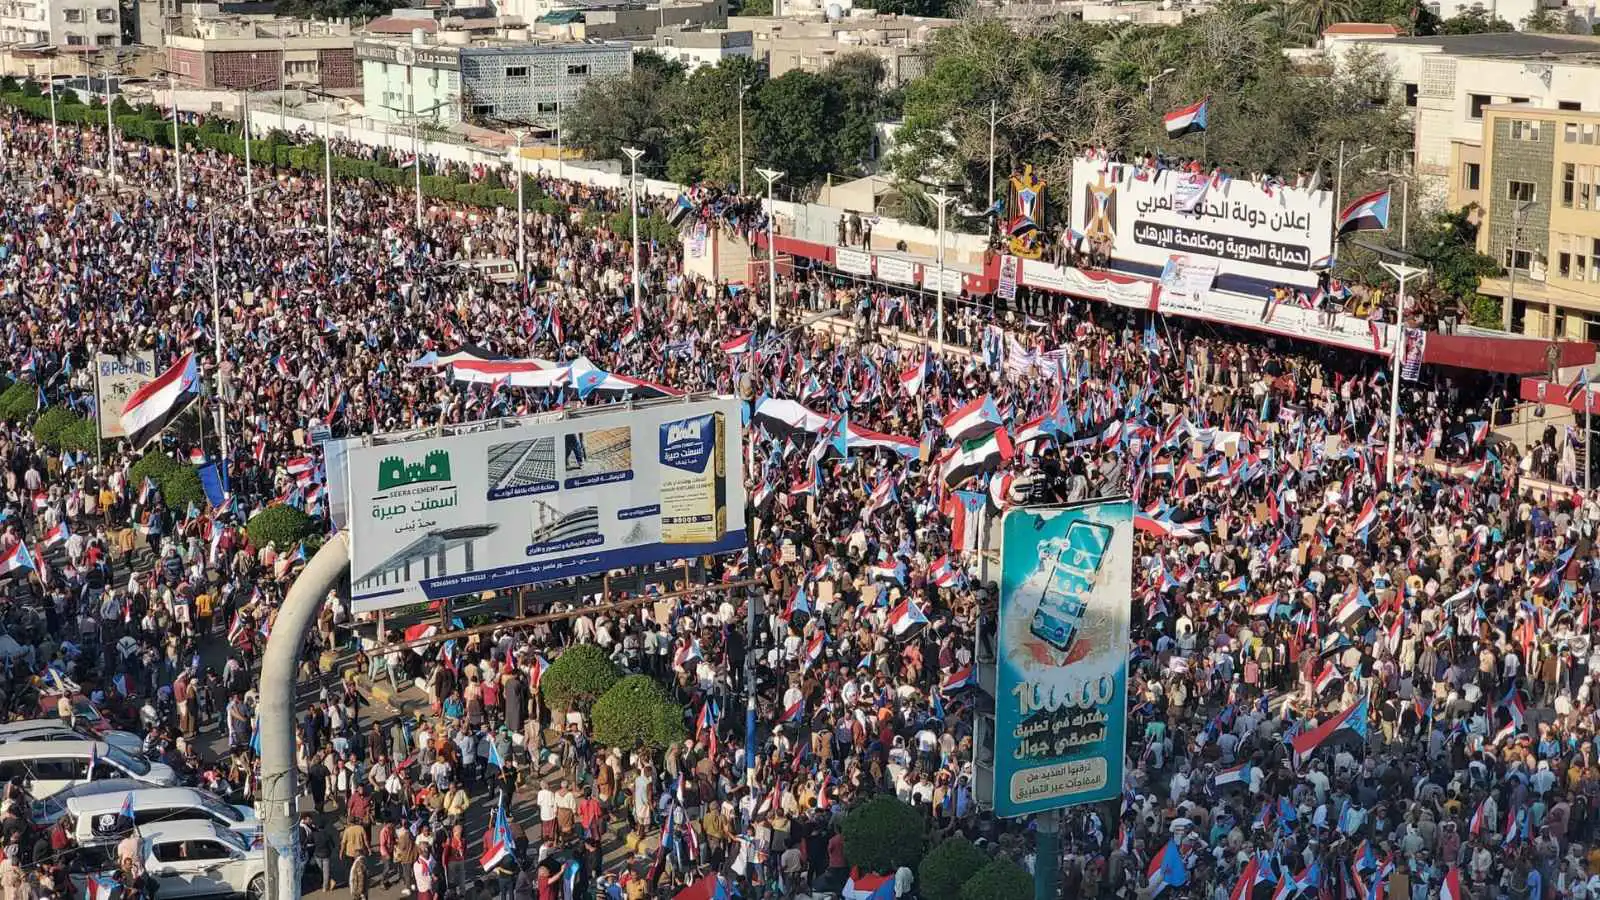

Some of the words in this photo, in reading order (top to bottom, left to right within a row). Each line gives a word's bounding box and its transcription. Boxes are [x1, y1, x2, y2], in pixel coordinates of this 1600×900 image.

[1136, 193, 1173, 218] لعربي
[1232, 201, 1266, 228] دولة
[1271, 210, 1310, 238] إعلان
[1136, 225, 1173, 247] الإرهاب
[1175, 228, 1225, 255] ومكافحة
[1226, 237, 1266, 259] العروبة
[1268, 244, 1308, 265] لحماية
[111, 361, 152, 376] Perins
[664, 450, 680, 462] صيرة
[681, 444, 704, 457] أسمنت
[411, 489, 457, 512] أسمنت
[412, 485, 438, 496] CEMENT
[372, 503, 406, 520] صيرة
[1052, 717, 1069, 734] في
[1072, 709, 1109, 727] مشترك
[1013, 720, 1049, 738] تطبيق
[1014, 739, 1049, 759] جوال
[1054, 726, 1108, 755] العمقي
[1026, 774, 1039, 783] من
